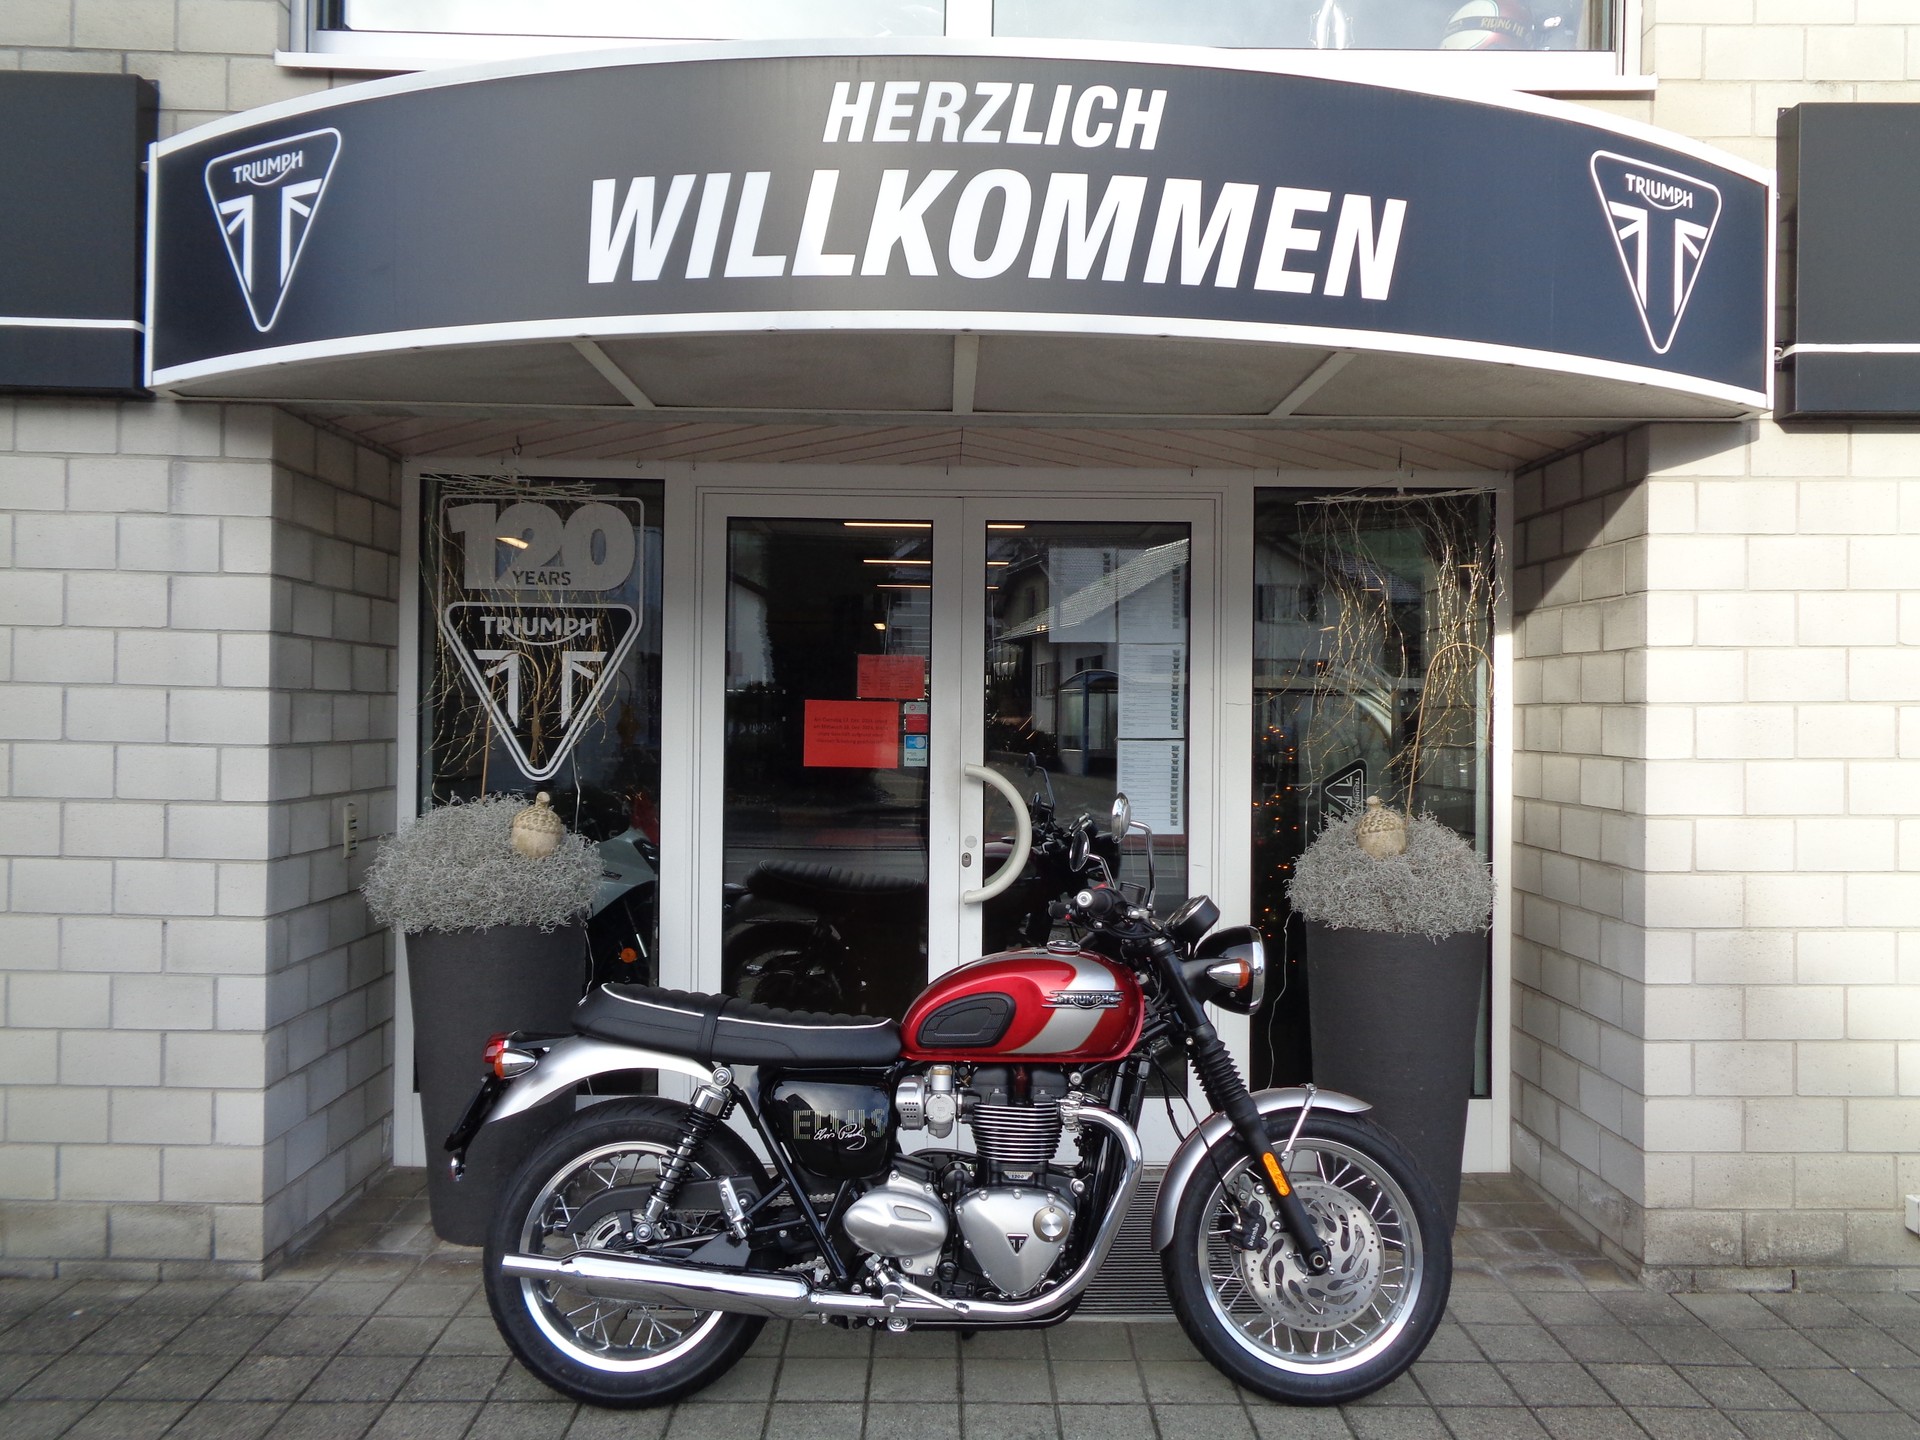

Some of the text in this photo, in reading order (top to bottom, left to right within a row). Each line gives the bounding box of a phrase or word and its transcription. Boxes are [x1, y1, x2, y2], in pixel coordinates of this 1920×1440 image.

[822, 81, 1168, 150] HERZLICH
[232, 150, 304, 186] TRIUMPH
[1625, 173, 1694, 211] TRIUMPH
[588, 169, 1408, 300] WILLKOMMEN
[447, 501, 636, 591] 120
[512, 570, 572, 587] YEARS
[479, 614, 599, 646] TRIUMPH
[1061, 994, 1111, 1009] TRIUMPH
[1248, 1222, 1260, 1247] brembo
